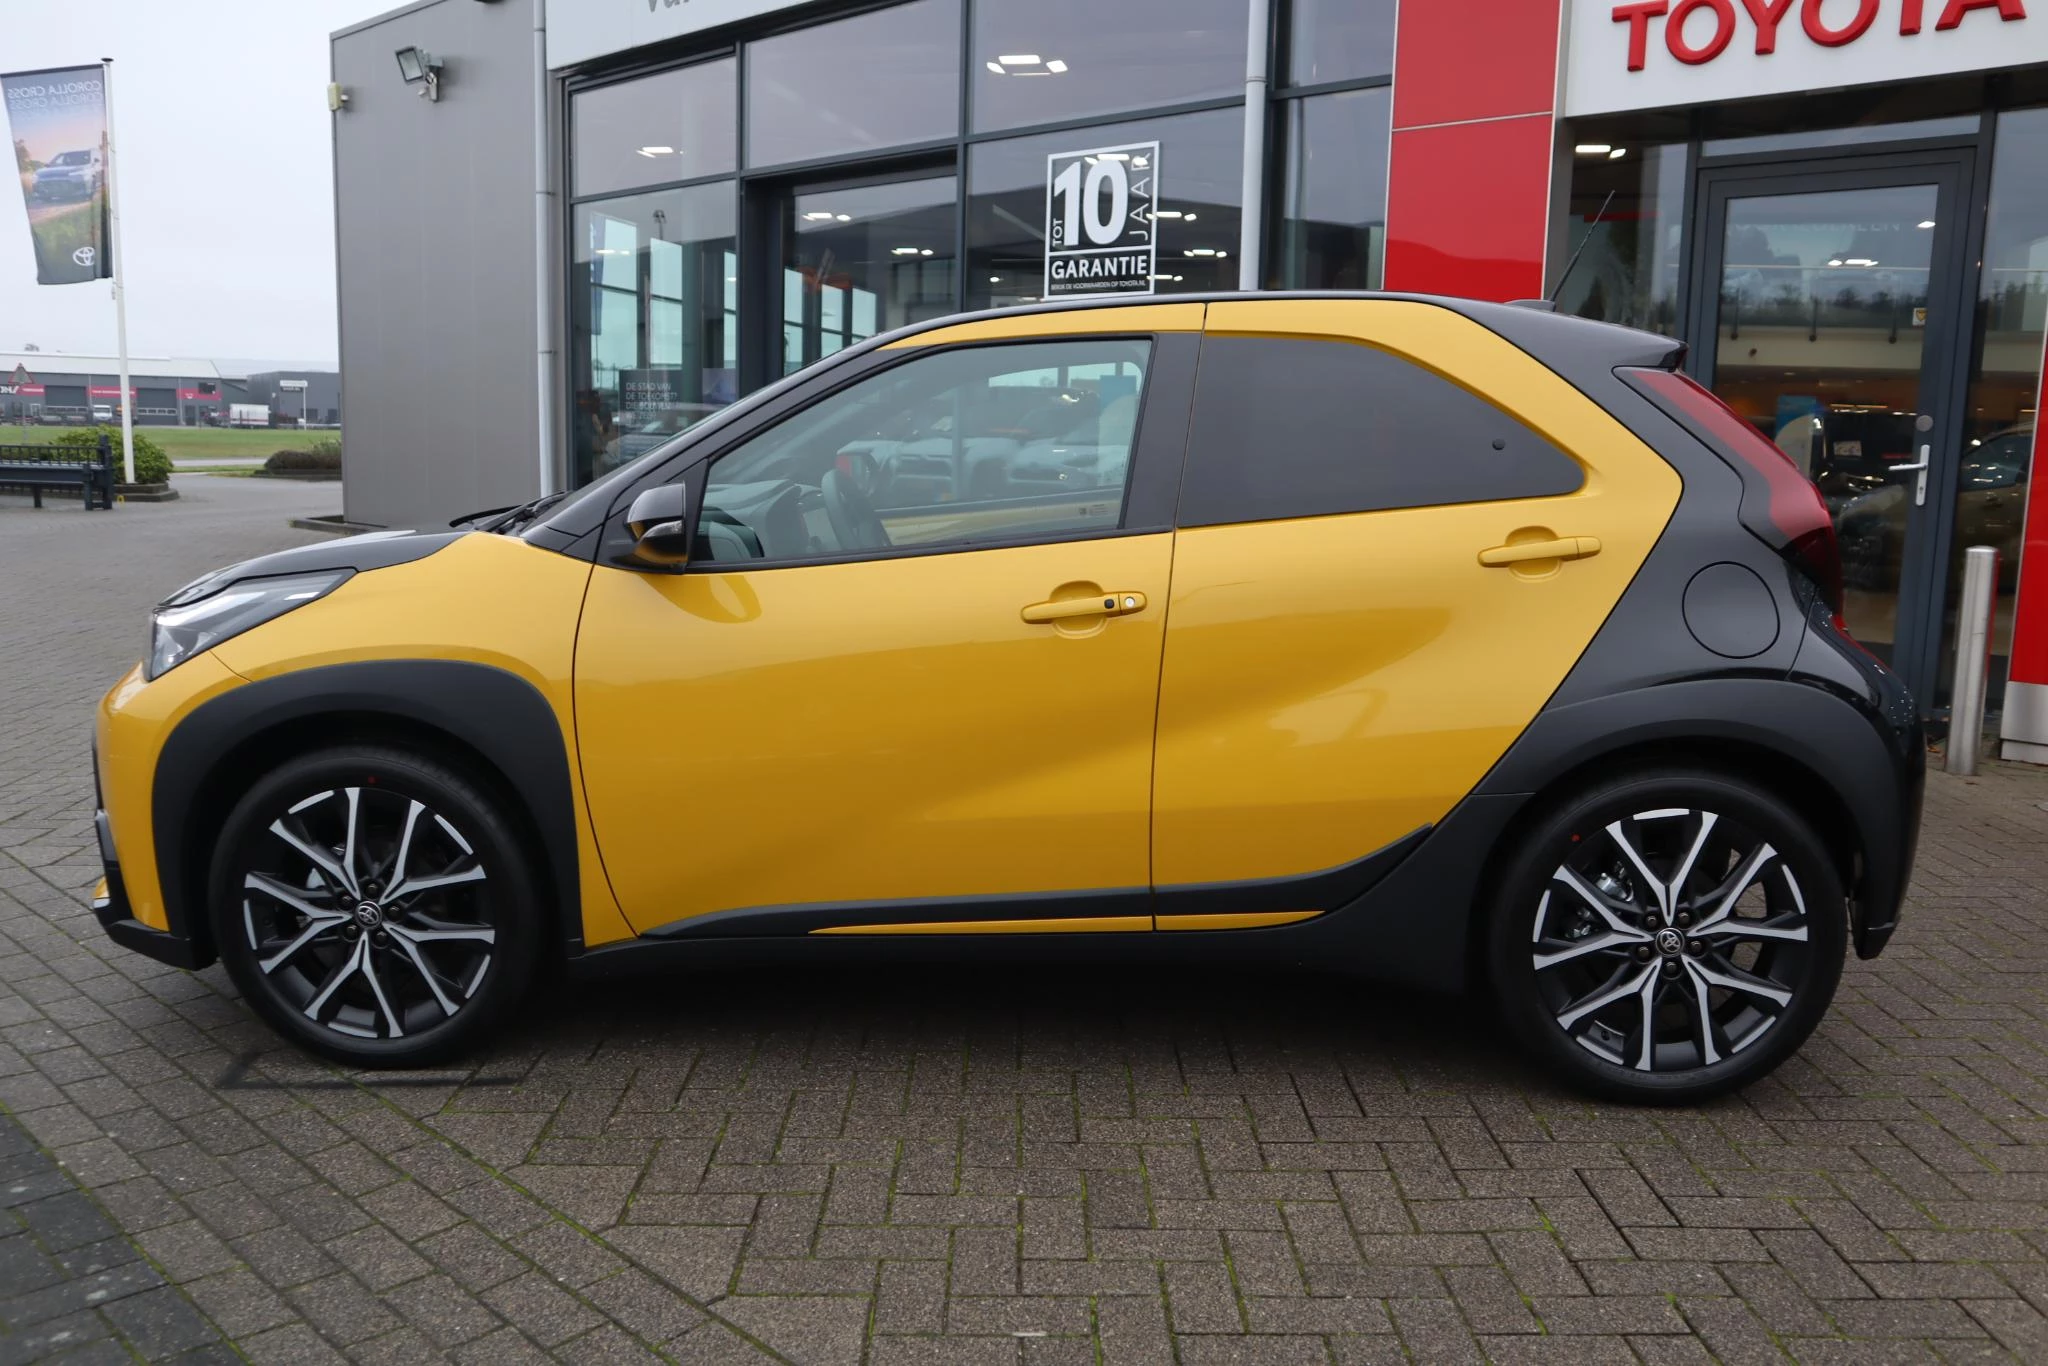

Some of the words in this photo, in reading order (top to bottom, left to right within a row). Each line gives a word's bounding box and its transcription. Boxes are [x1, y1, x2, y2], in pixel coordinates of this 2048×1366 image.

[1054, 159, 1128, 246] 10
[1129, 153, 1150, 241] JAAR
[1053, 218, 1063, 247] TOT
[1051, 255, 1147, 279] GARANTIE
[625, 382, 636, 391] DE
[625, 391, 636, 400] DE
